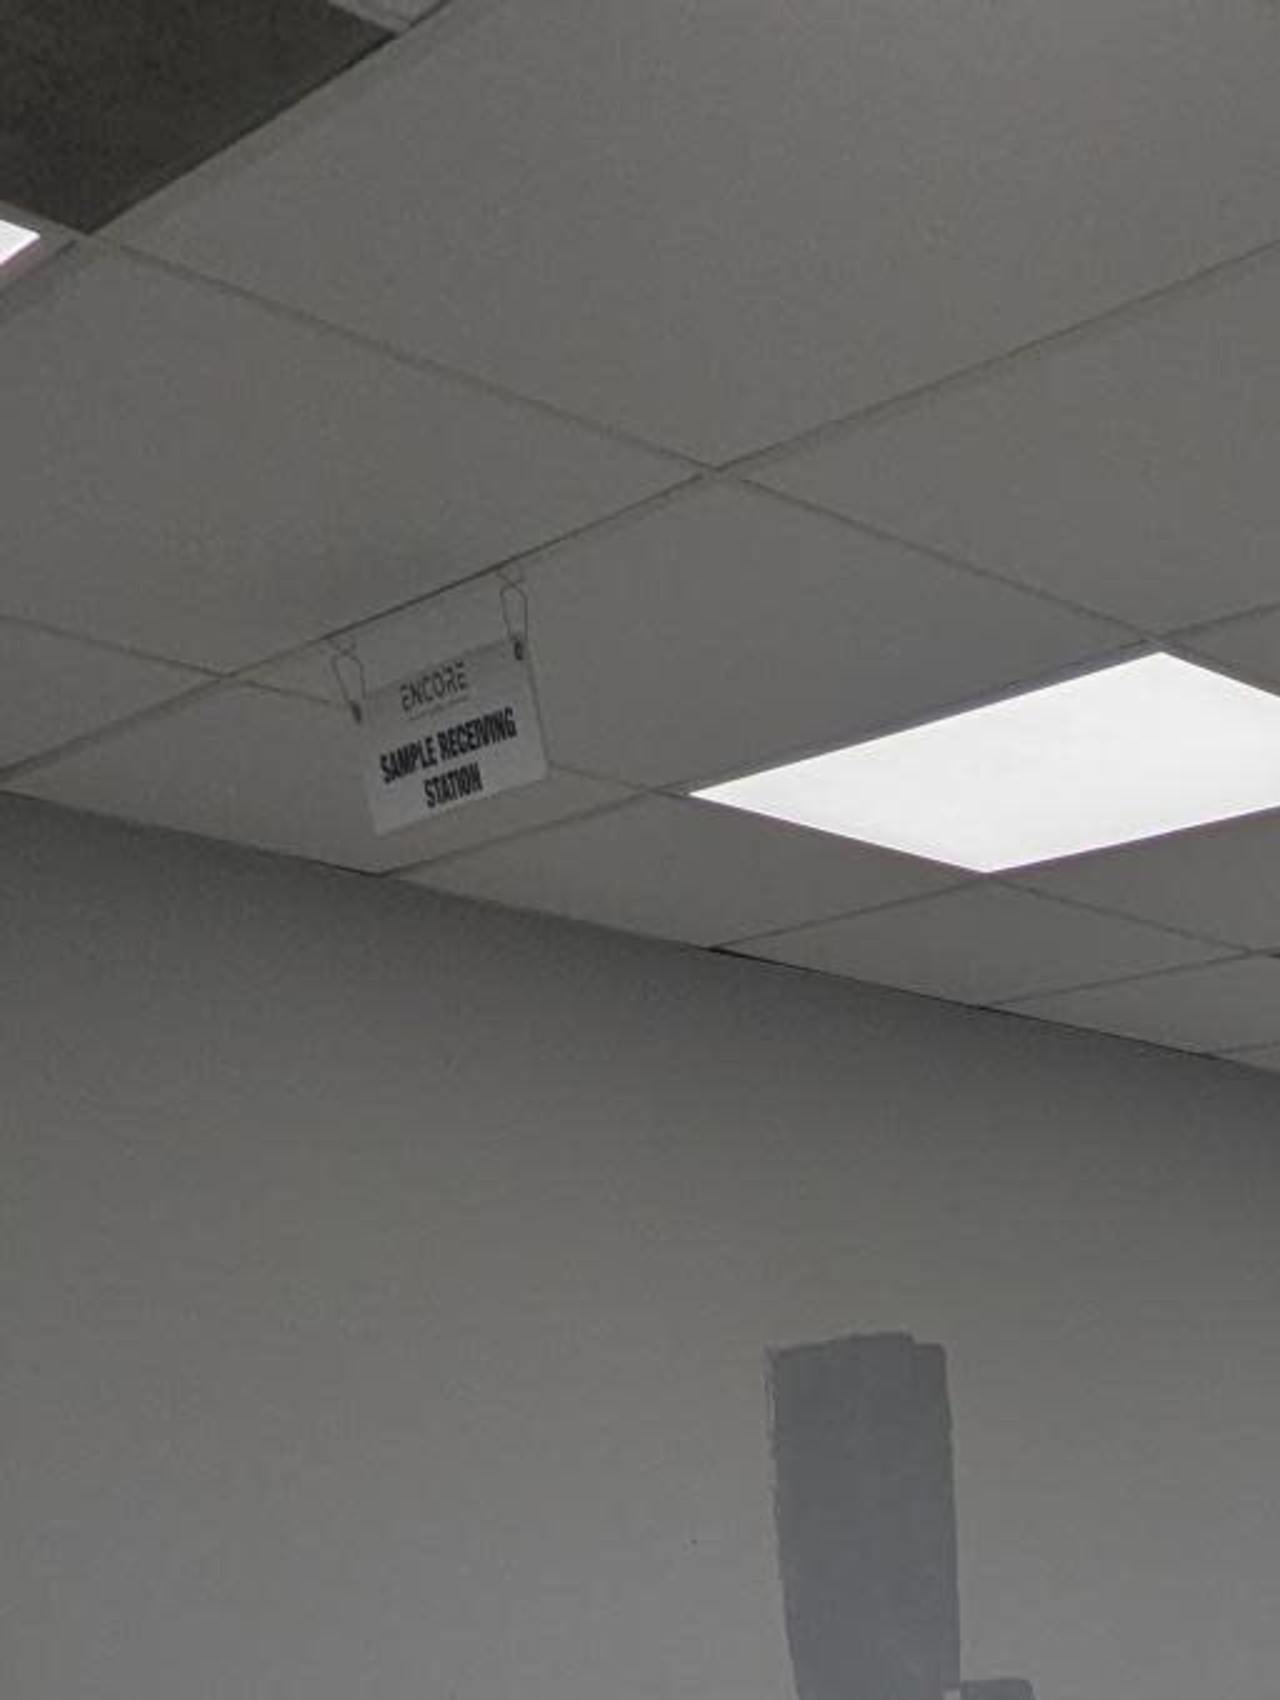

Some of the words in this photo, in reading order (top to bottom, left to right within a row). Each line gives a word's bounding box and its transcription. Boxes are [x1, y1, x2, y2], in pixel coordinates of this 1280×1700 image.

[400, 661, 468, 712] ENCORE
[380, 737, 437, 784] SAMPLE
[437, 706, 518, 761] RECEIVING
[424, 762, 483, 808] STATION
